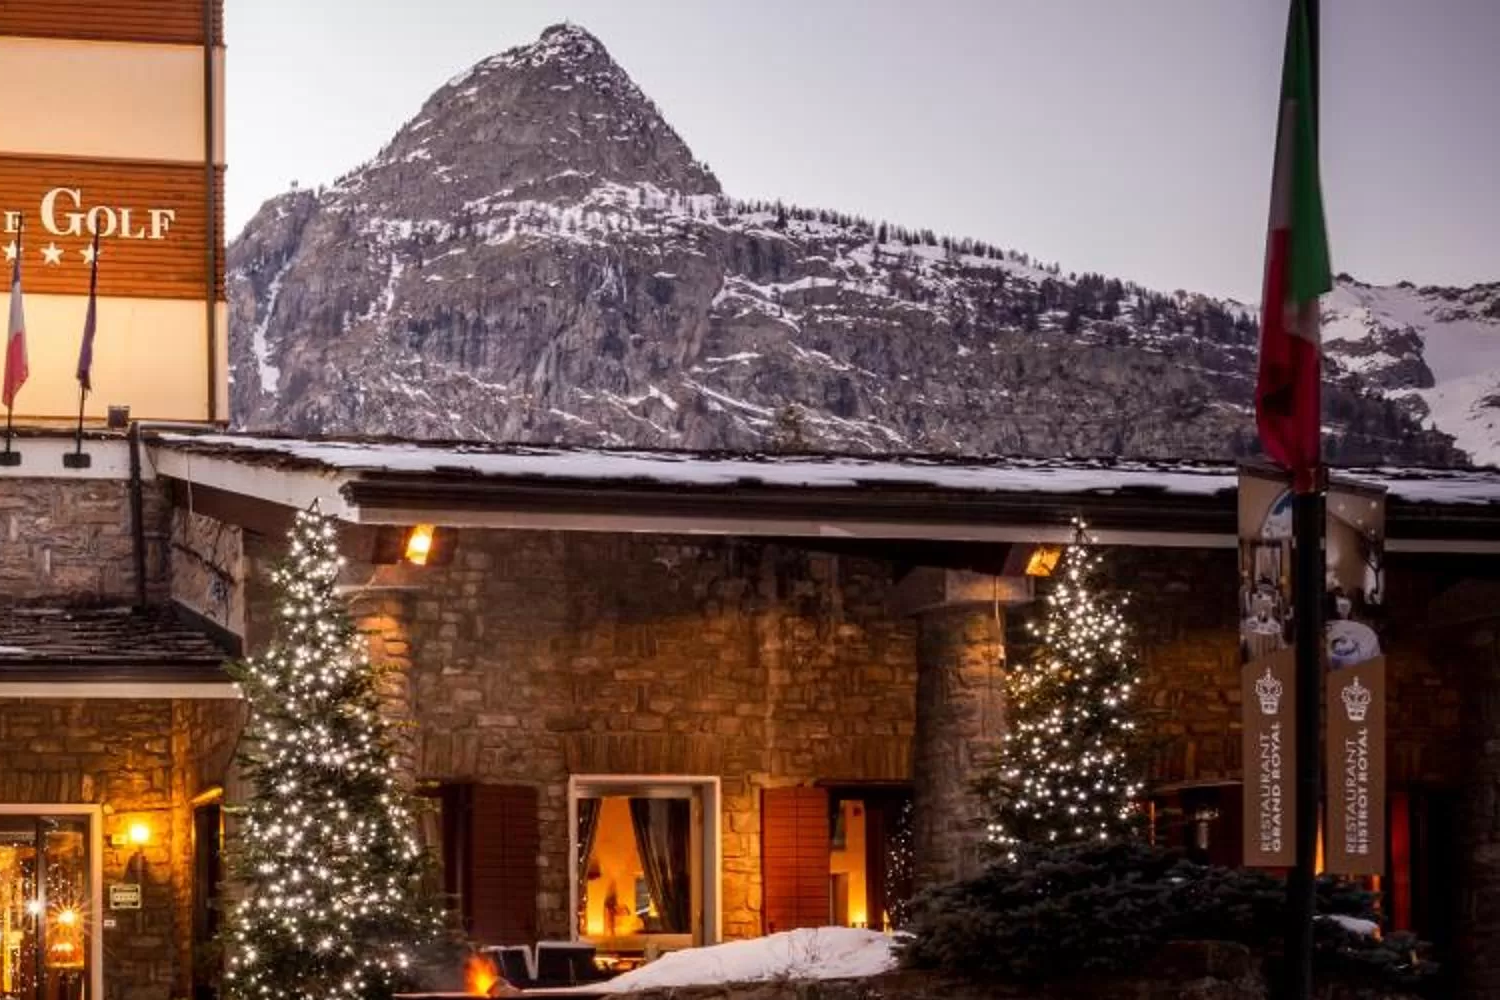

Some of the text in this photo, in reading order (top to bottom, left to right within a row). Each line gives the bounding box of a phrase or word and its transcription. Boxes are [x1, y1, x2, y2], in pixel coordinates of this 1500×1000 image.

[4, 211, 23, 233] E
[40, 187, 175, 239] GOLF
[1271, 721, 1282, 853] GRAND ROYAL
[1346, 739, 1356, 854] RESTAURANT
[1357, 727, 1368, 782] ROYAL
